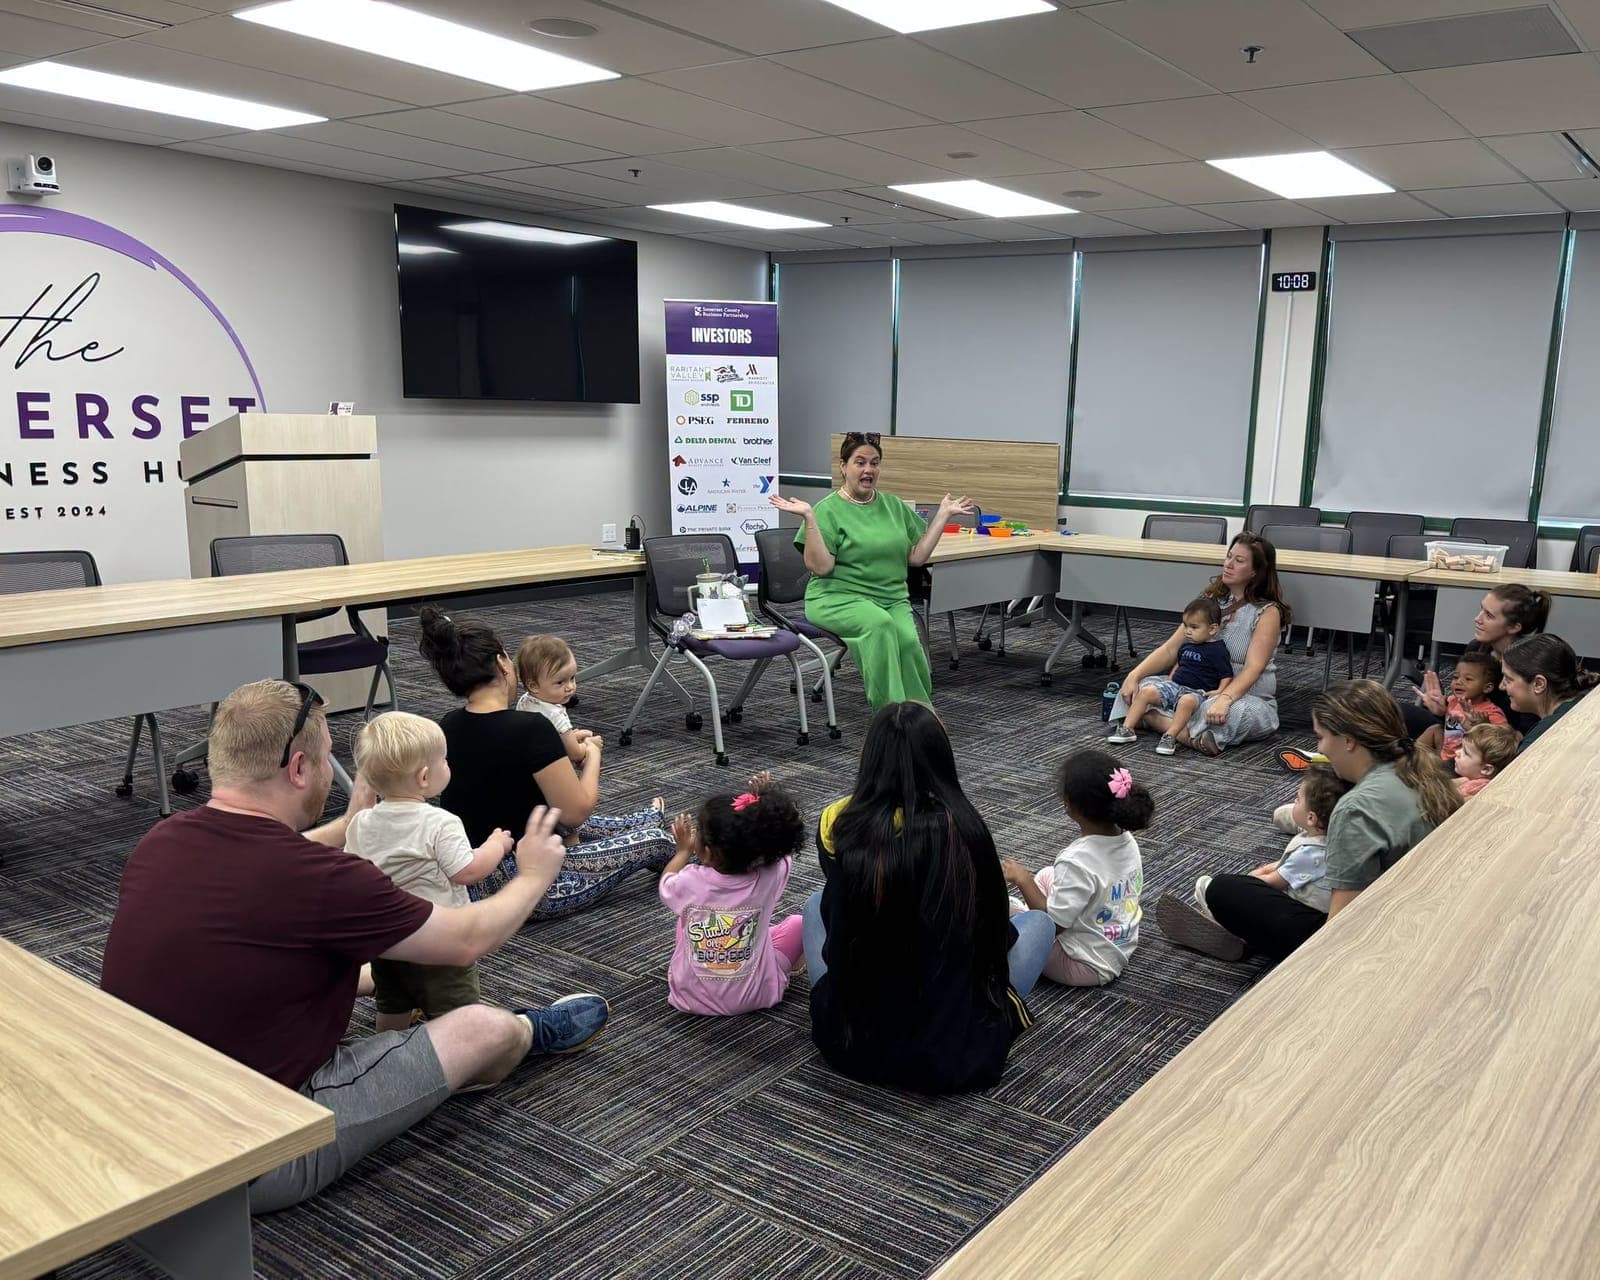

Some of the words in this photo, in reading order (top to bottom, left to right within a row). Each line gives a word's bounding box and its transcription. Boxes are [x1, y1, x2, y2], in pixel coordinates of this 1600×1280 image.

[1276, 274, 1309, 289] 10:08
[0, 272, 125, 370] the
[691, 327, 753, 344] INVESTORS
[700, 393, 720, 404] ssp
[732, 393, 752, 408] TD
[688, 416, 714, 425] PSEG
[726, 417, 770, 425] FERRERO
[685, 437, 708, 445] DELTA
[708, 437, 737, 445] DENTAL
[743, 437, 774, 446] brother
[753, 456, 772, 464] Cleef
[5, 507, 44, 520] EST
[57, 505, 107, 517] 2024
[685, 504, 718, 512] ALPINE
[745, 522, 765, 531] Roche
[688, 919, 731, 943] Stuck
